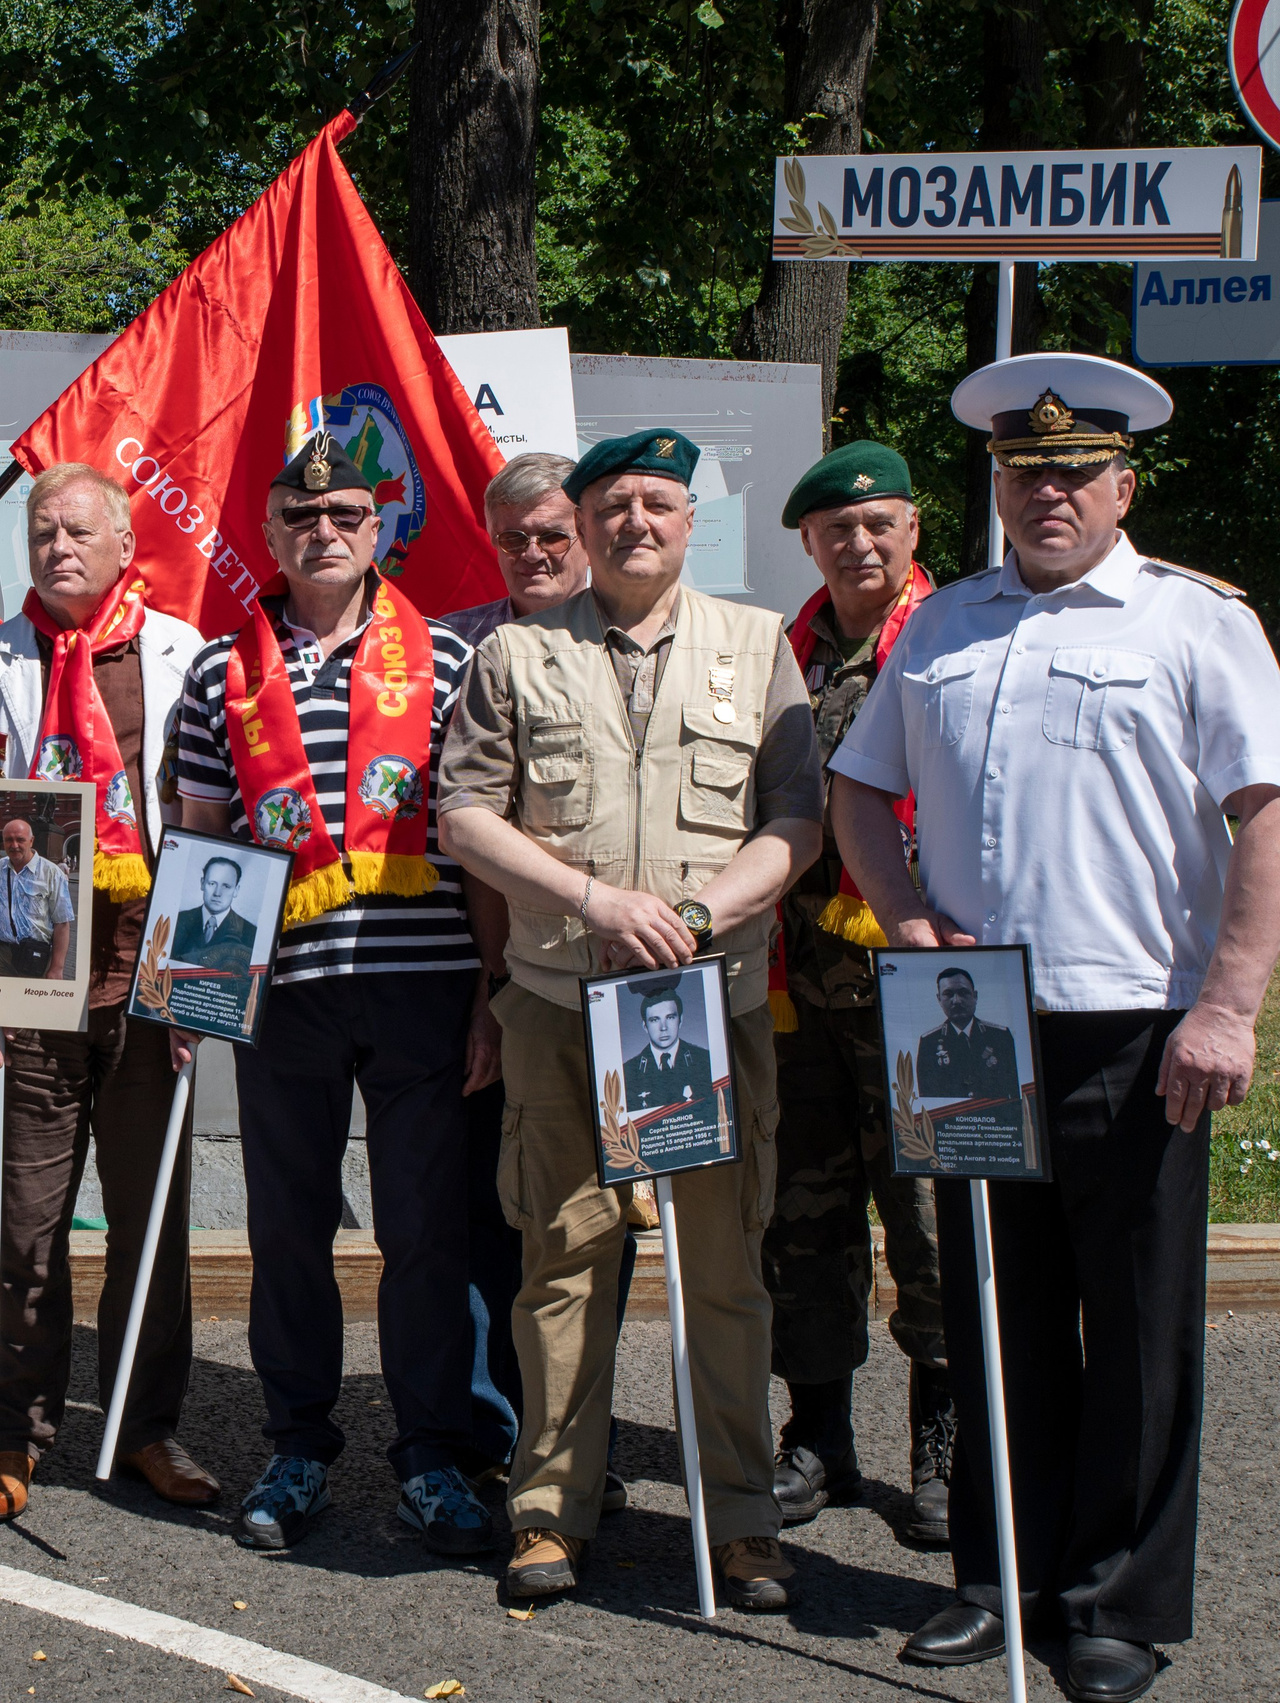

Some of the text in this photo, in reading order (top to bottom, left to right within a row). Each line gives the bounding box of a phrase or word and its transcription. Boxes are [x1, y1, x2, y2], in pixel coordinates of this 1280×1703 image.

[841, 162, 1171, 228] МОЗАМБИК
[1140, 270, 1270, 307] Аллея
[115, 437, 205, 533] СОЮЗ
[377, 626, 408, 717] Союз
[184, 983, 205, 992] Евгений
[199, 980, 221, 989] КИРЕЕВ
[24, 987, 48, 997] Игорь
[50, 989, 74, 998] Лосев
[662, 1114, 693, 1125] ЛУКЬЯНОВ
[649, 1120, 703, 1134] Сергей Васильевич
